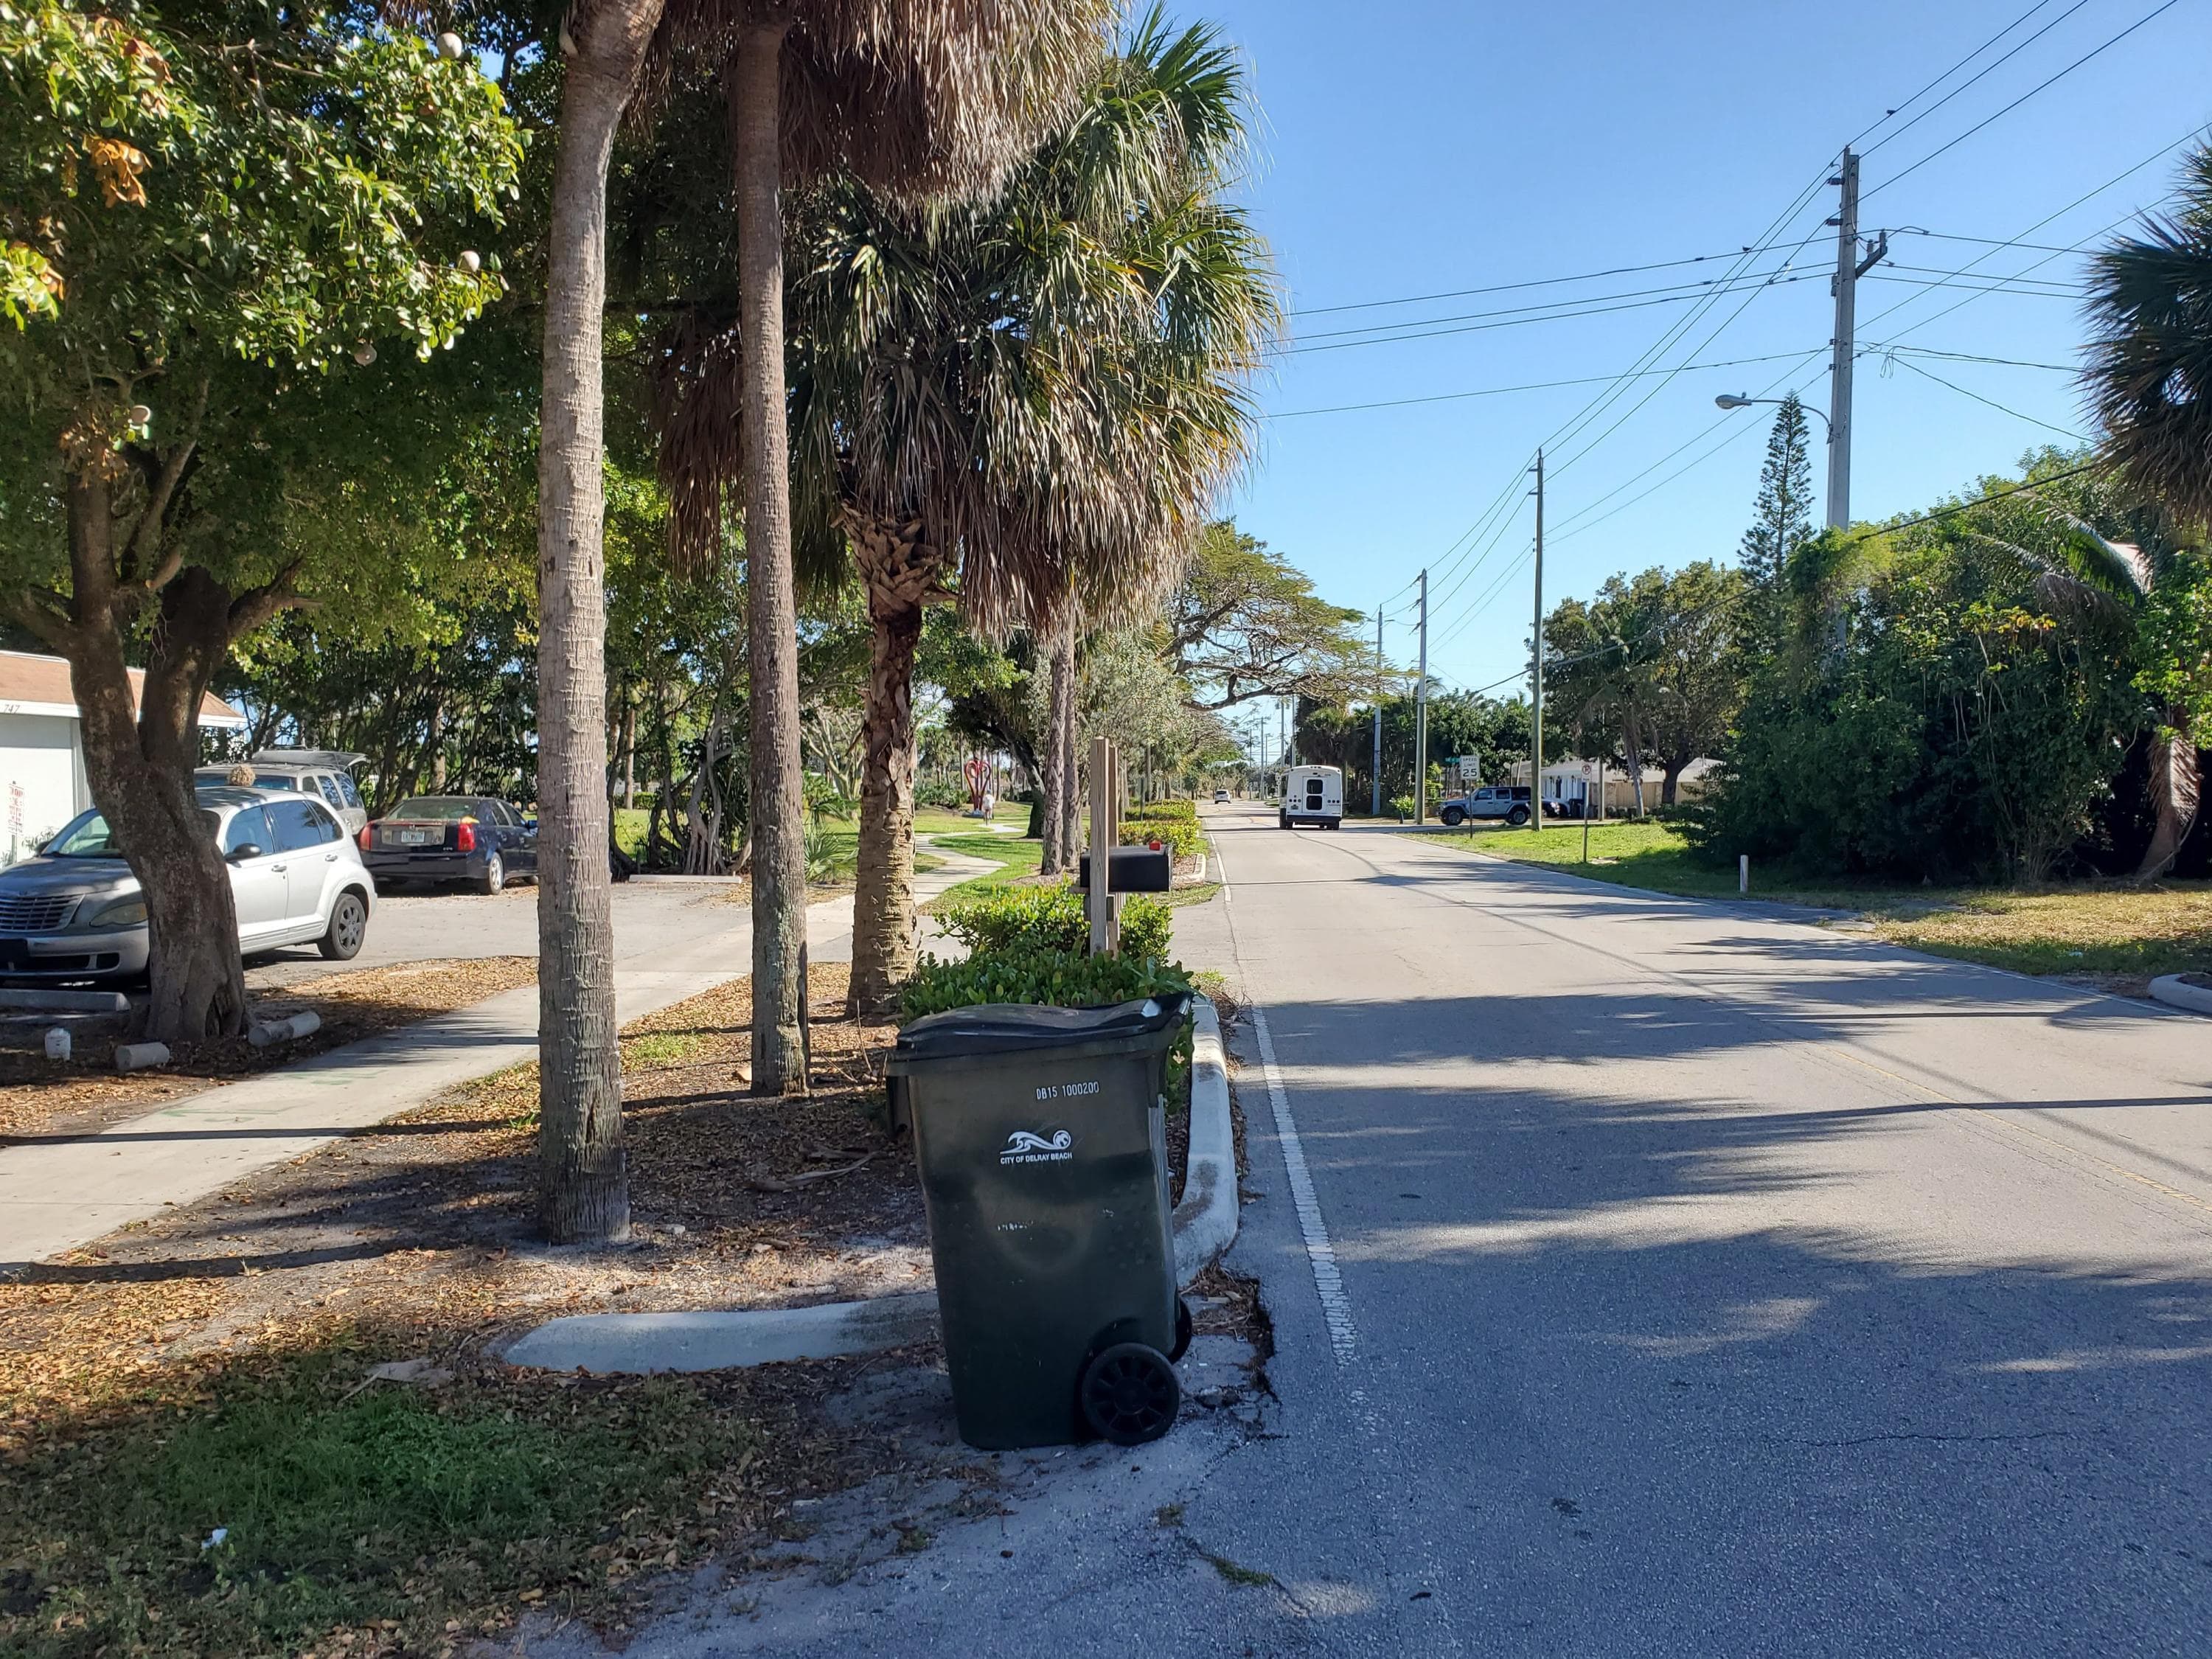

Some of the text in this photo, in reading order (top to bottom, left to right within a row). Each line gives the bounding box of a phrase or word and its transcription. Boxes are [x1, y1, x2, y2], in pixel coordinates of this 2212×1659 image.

[1462, 768, 1478, 777] 25
[1062, 1081, 1099, 1097] 1000200
[1001, 1152, 1073, 1164] CITY OF DELRAY BEACH
